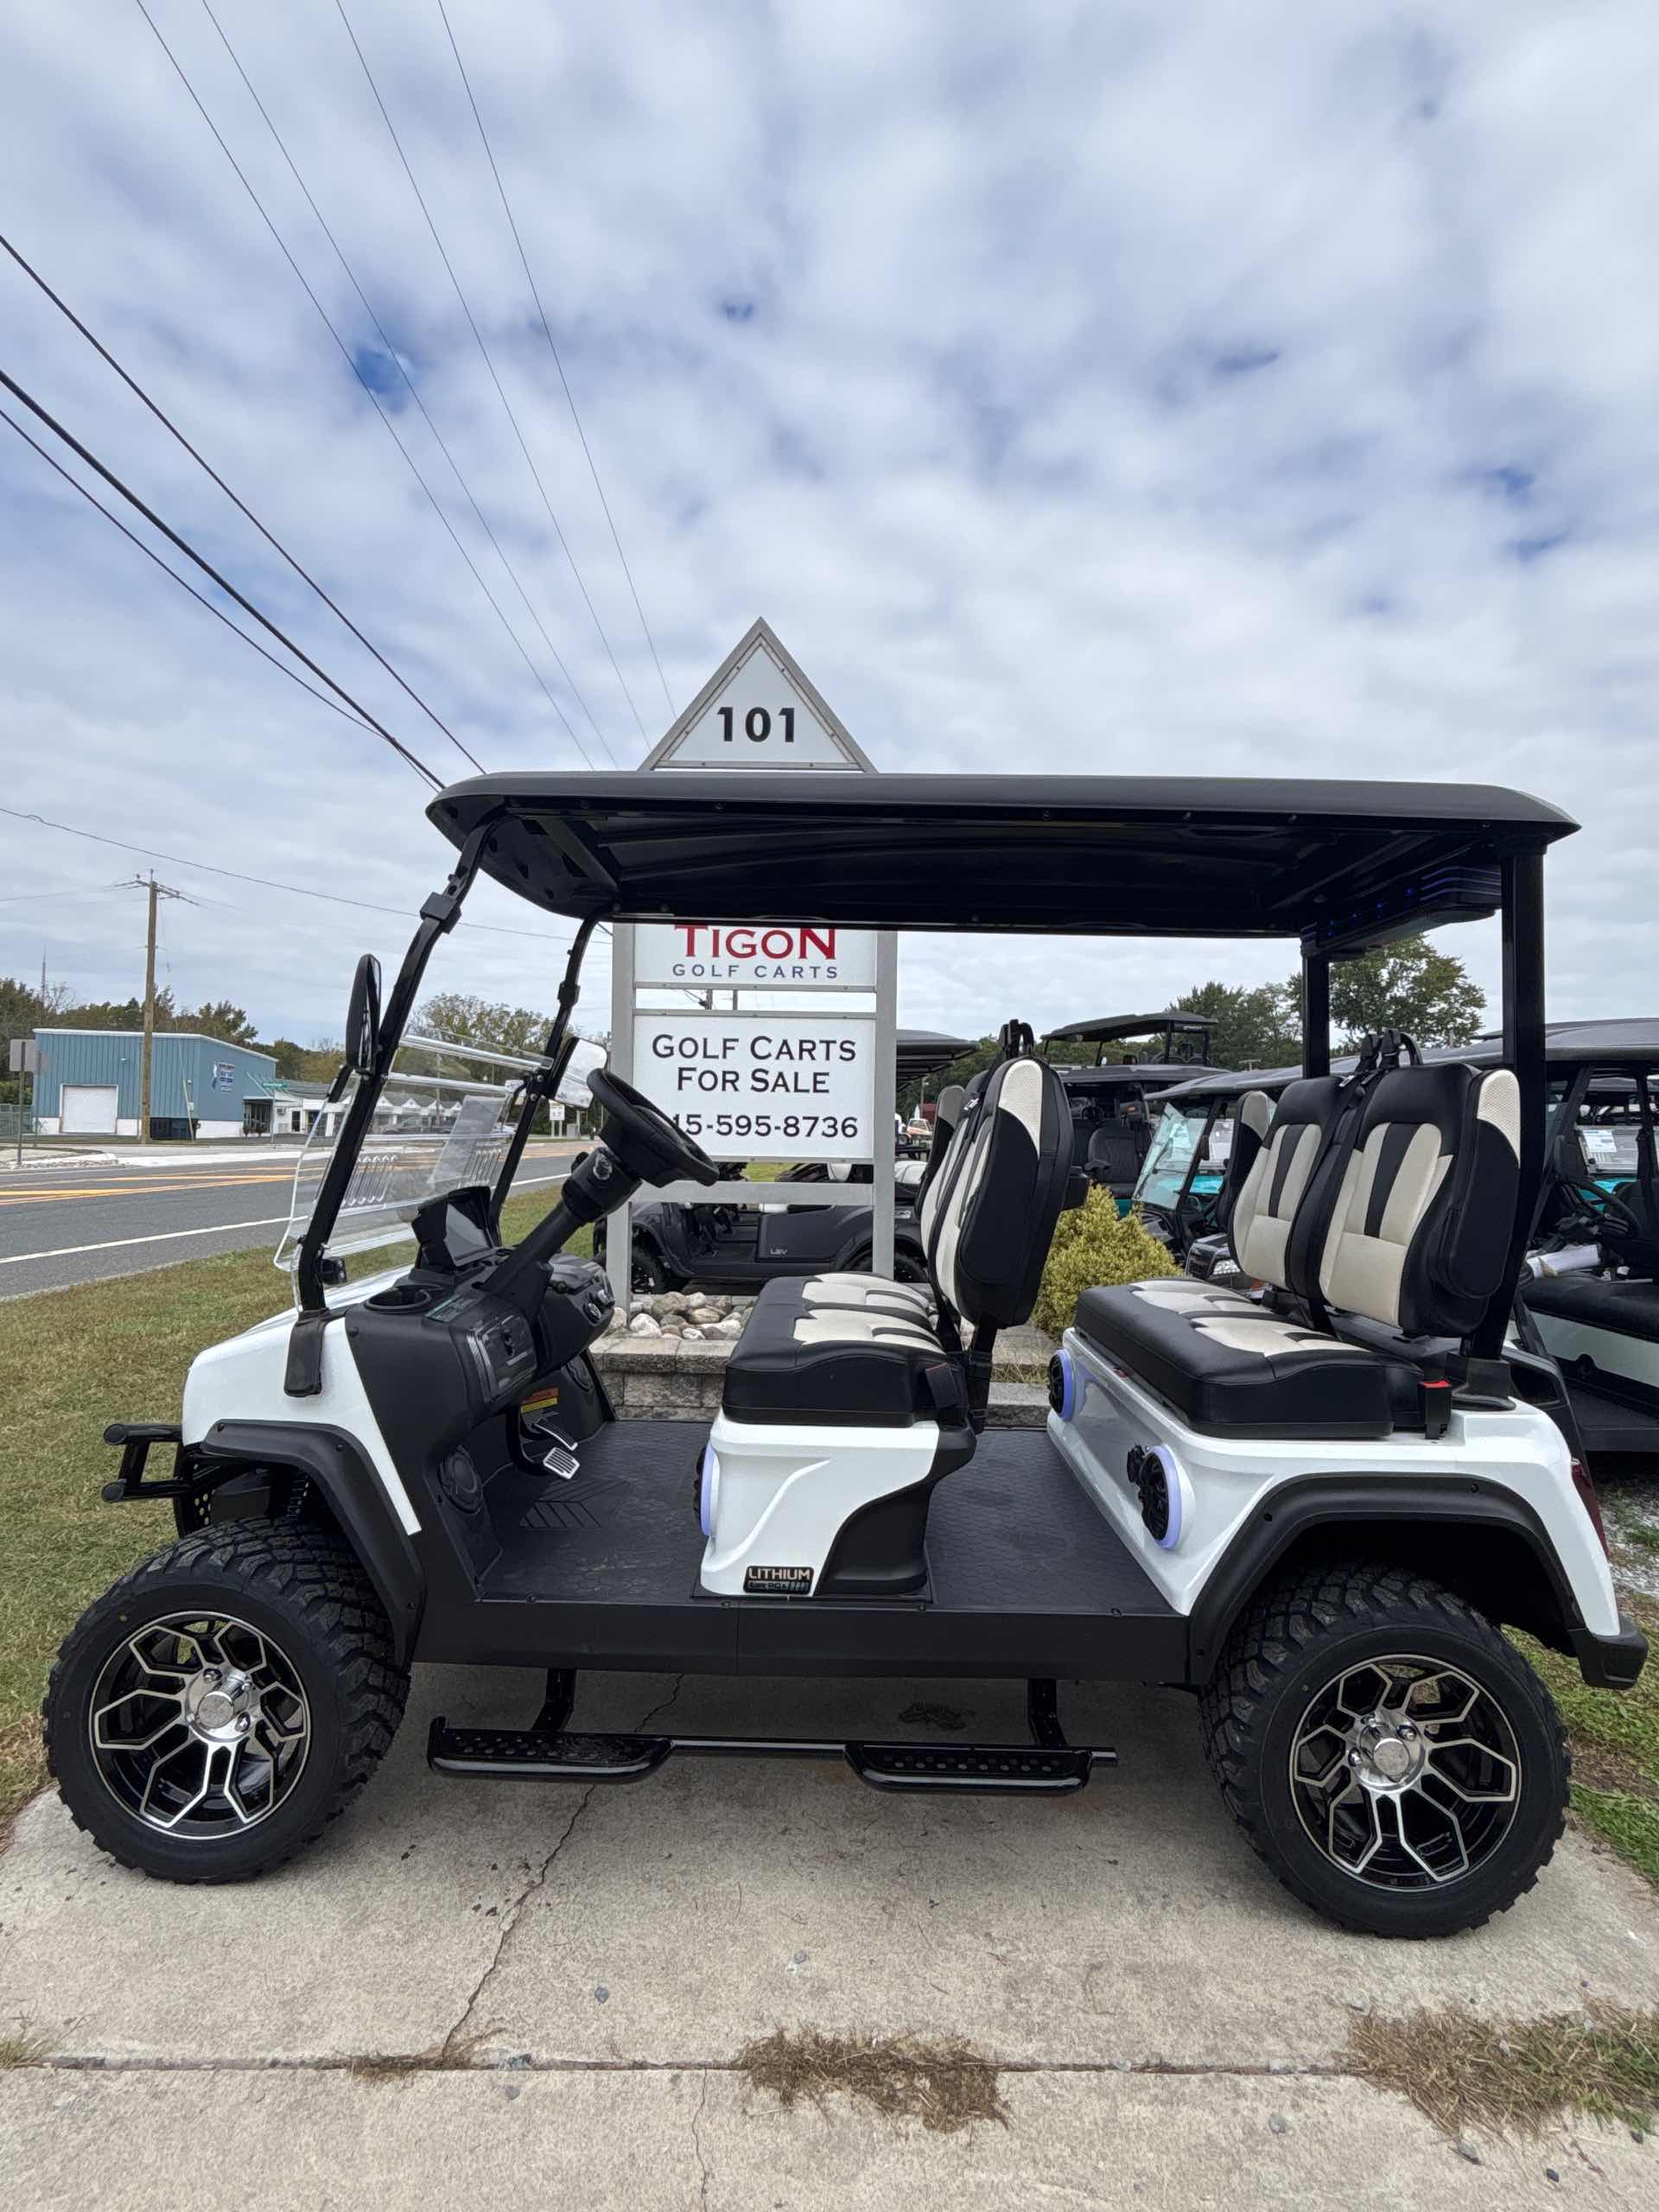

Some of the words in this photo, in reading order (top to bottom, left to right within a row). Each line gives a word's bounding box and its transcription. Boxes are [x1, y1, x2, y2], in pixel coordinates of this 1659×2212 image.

[716, 706, 795, 742] 101
[675, 924, 836, 959] TIGON
[672, 963, 740, 977] GOLF
[754, 965, 838, 979] CARTS
[652, 1033, 739, 1059] GOLF
[750, 1035, 856, 1061] CARTS
[677, 1066, 740, 1091] FOR
[750, 1068, 830, 1093] SALE
[672, 1114, 858, 1138] 15-595-8736
[748, 1567, 810, 1580] LITHIUM
